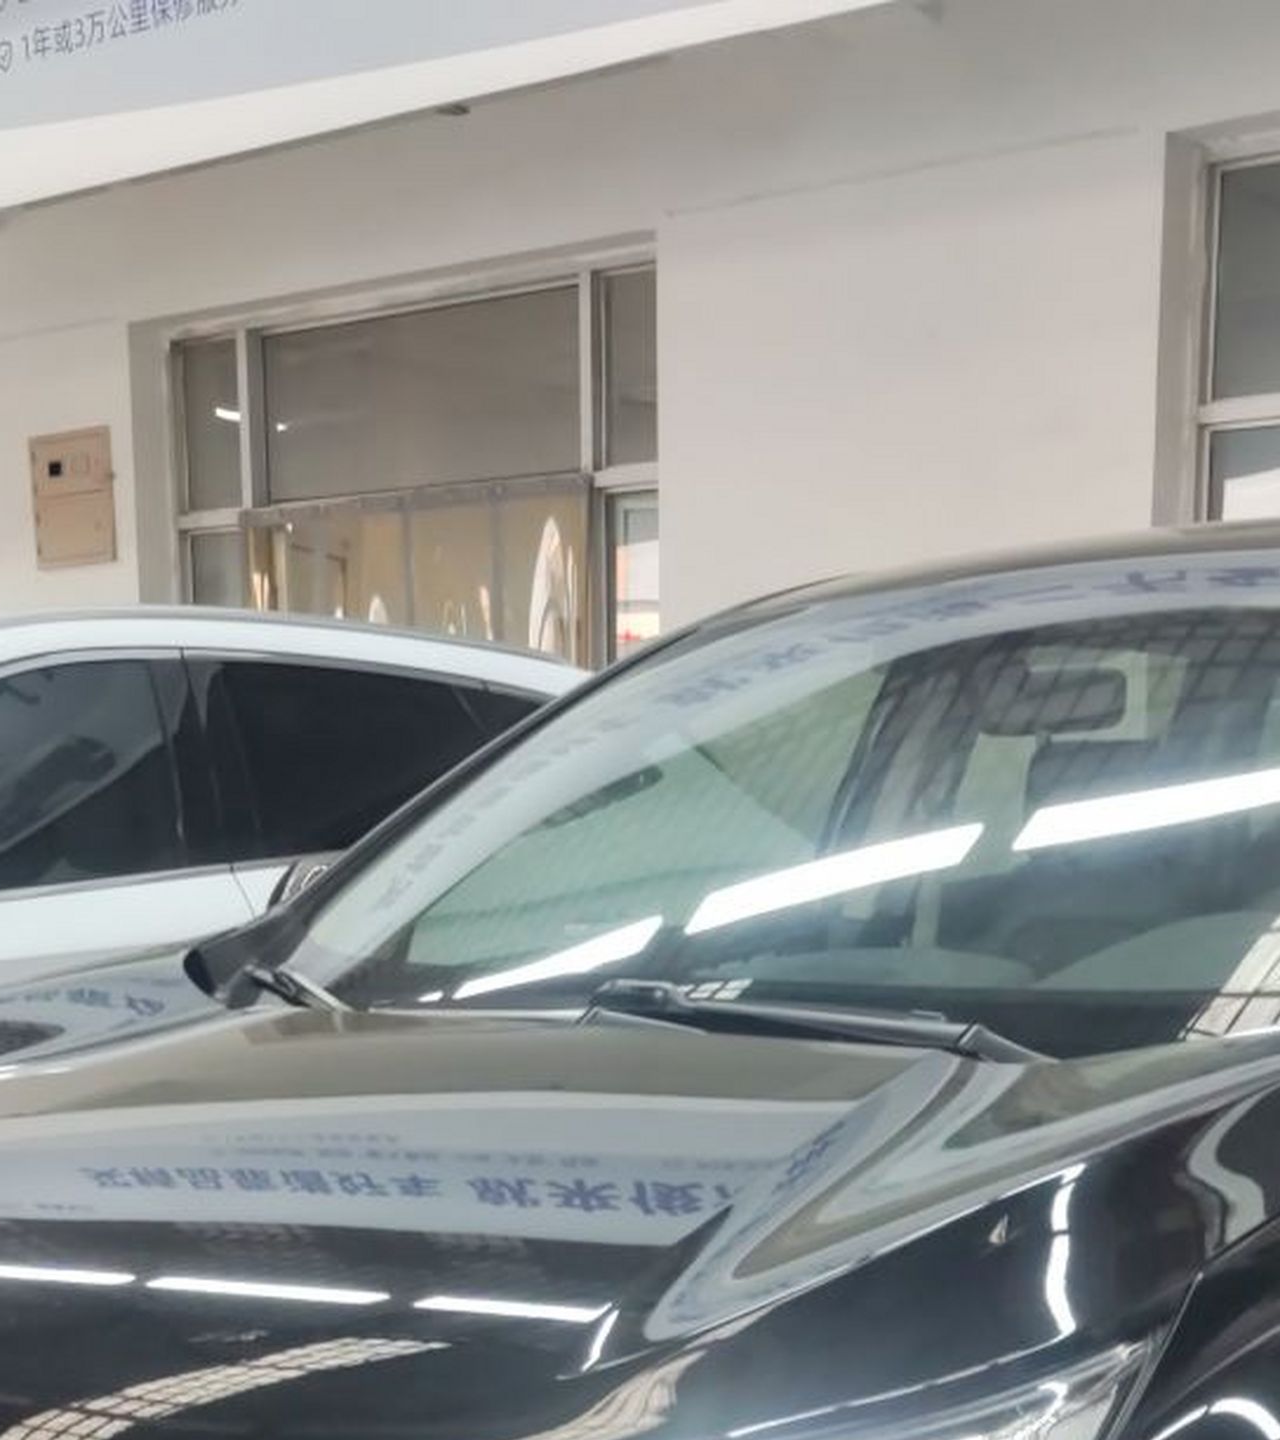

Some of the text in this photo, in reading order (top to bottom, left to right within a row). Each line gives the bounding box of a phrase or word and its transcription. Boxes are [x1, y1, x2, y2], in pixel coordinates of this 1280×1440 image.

[21, 0, 239, 60] 1年或3万公里保修
